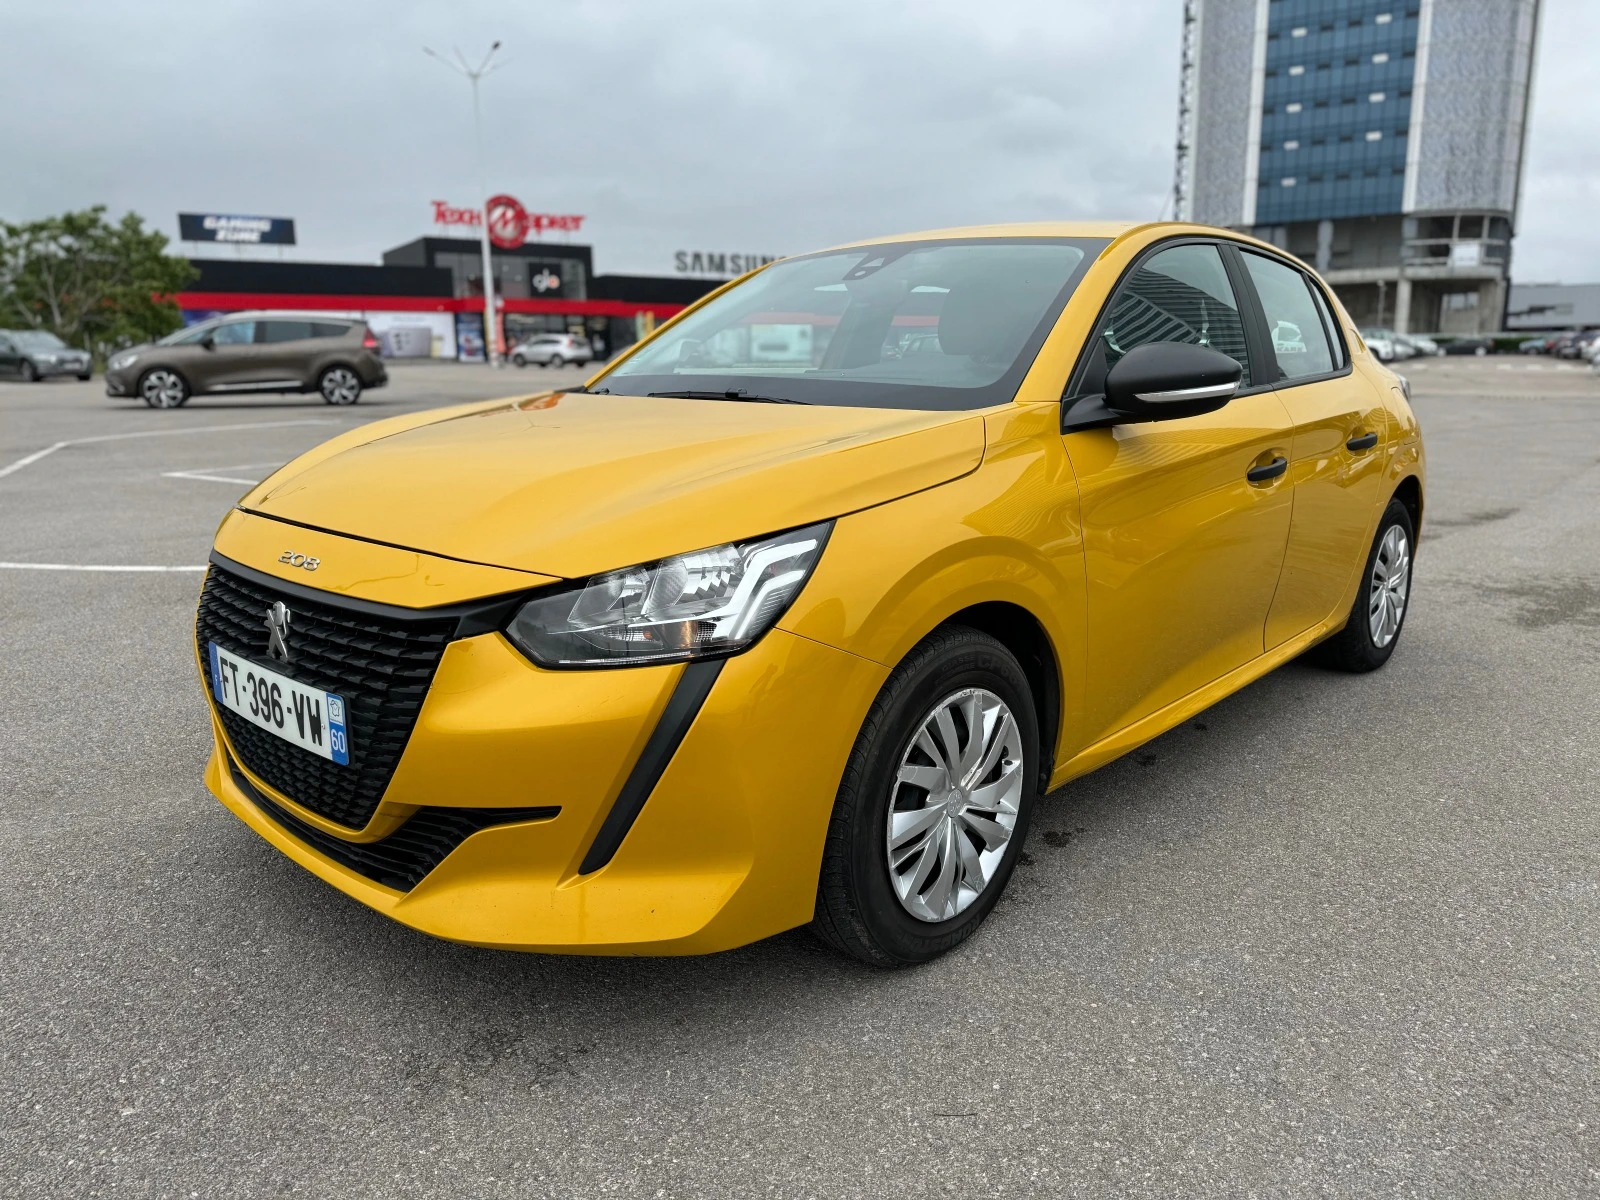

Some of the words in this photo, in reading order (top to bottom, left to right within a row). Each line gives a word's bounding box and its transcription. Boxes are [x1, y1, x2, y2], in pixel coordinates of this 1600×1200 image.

[278, 550, 321, 571] 208
[219, 656, 323, 746] FT-396-VW
[331, 728, 347, 754] 60
